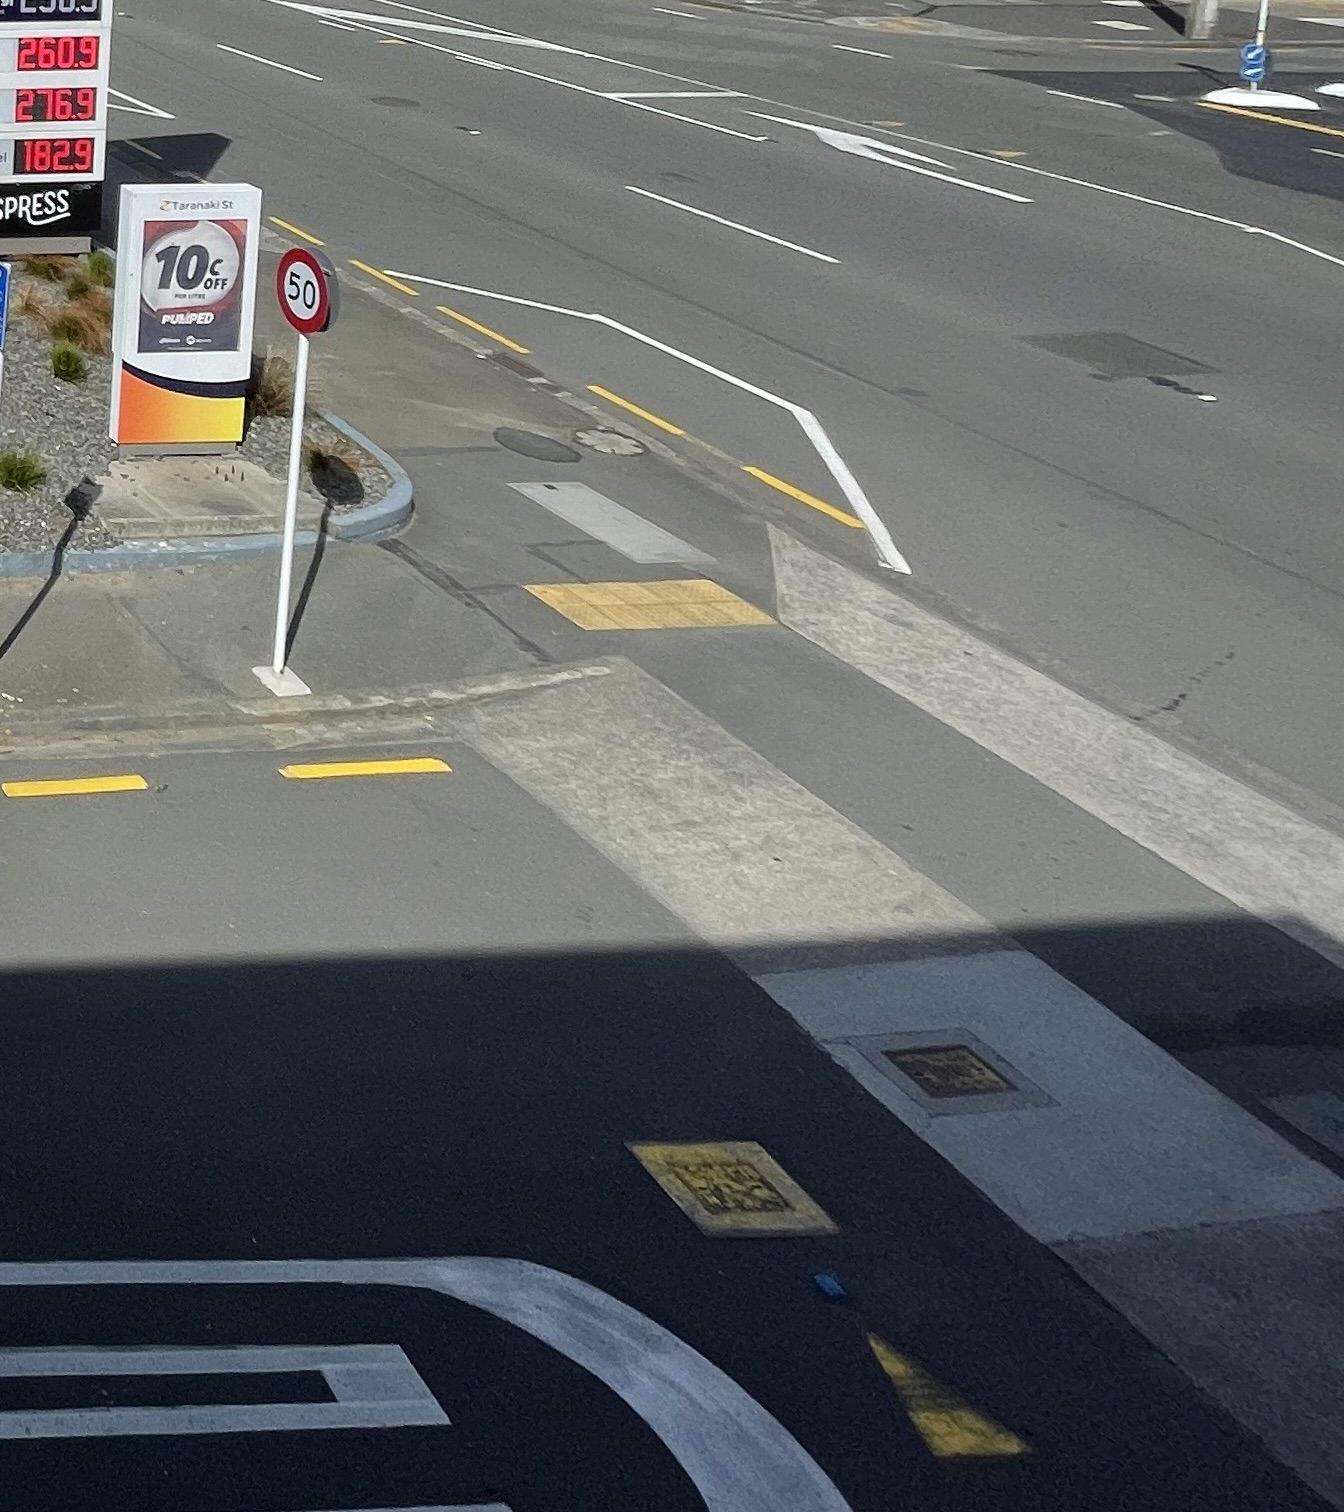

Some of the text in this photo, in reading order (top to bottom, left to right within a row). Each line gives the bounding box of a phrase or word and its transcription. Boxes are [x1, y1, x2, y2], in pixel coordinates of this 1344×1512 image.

[18, 36, 97, 69] 260.9
[16, 88, 95, 121] 276.9
[23, 139, 93, 172] 182.9
[172, 200, 220, 211] Taranaki
[221, 200, 234, 210] St
[203, 277, 229, 291] OFF
[288, 271, 316, 310] 50
[161, 311, 215, 326] PUMPED
